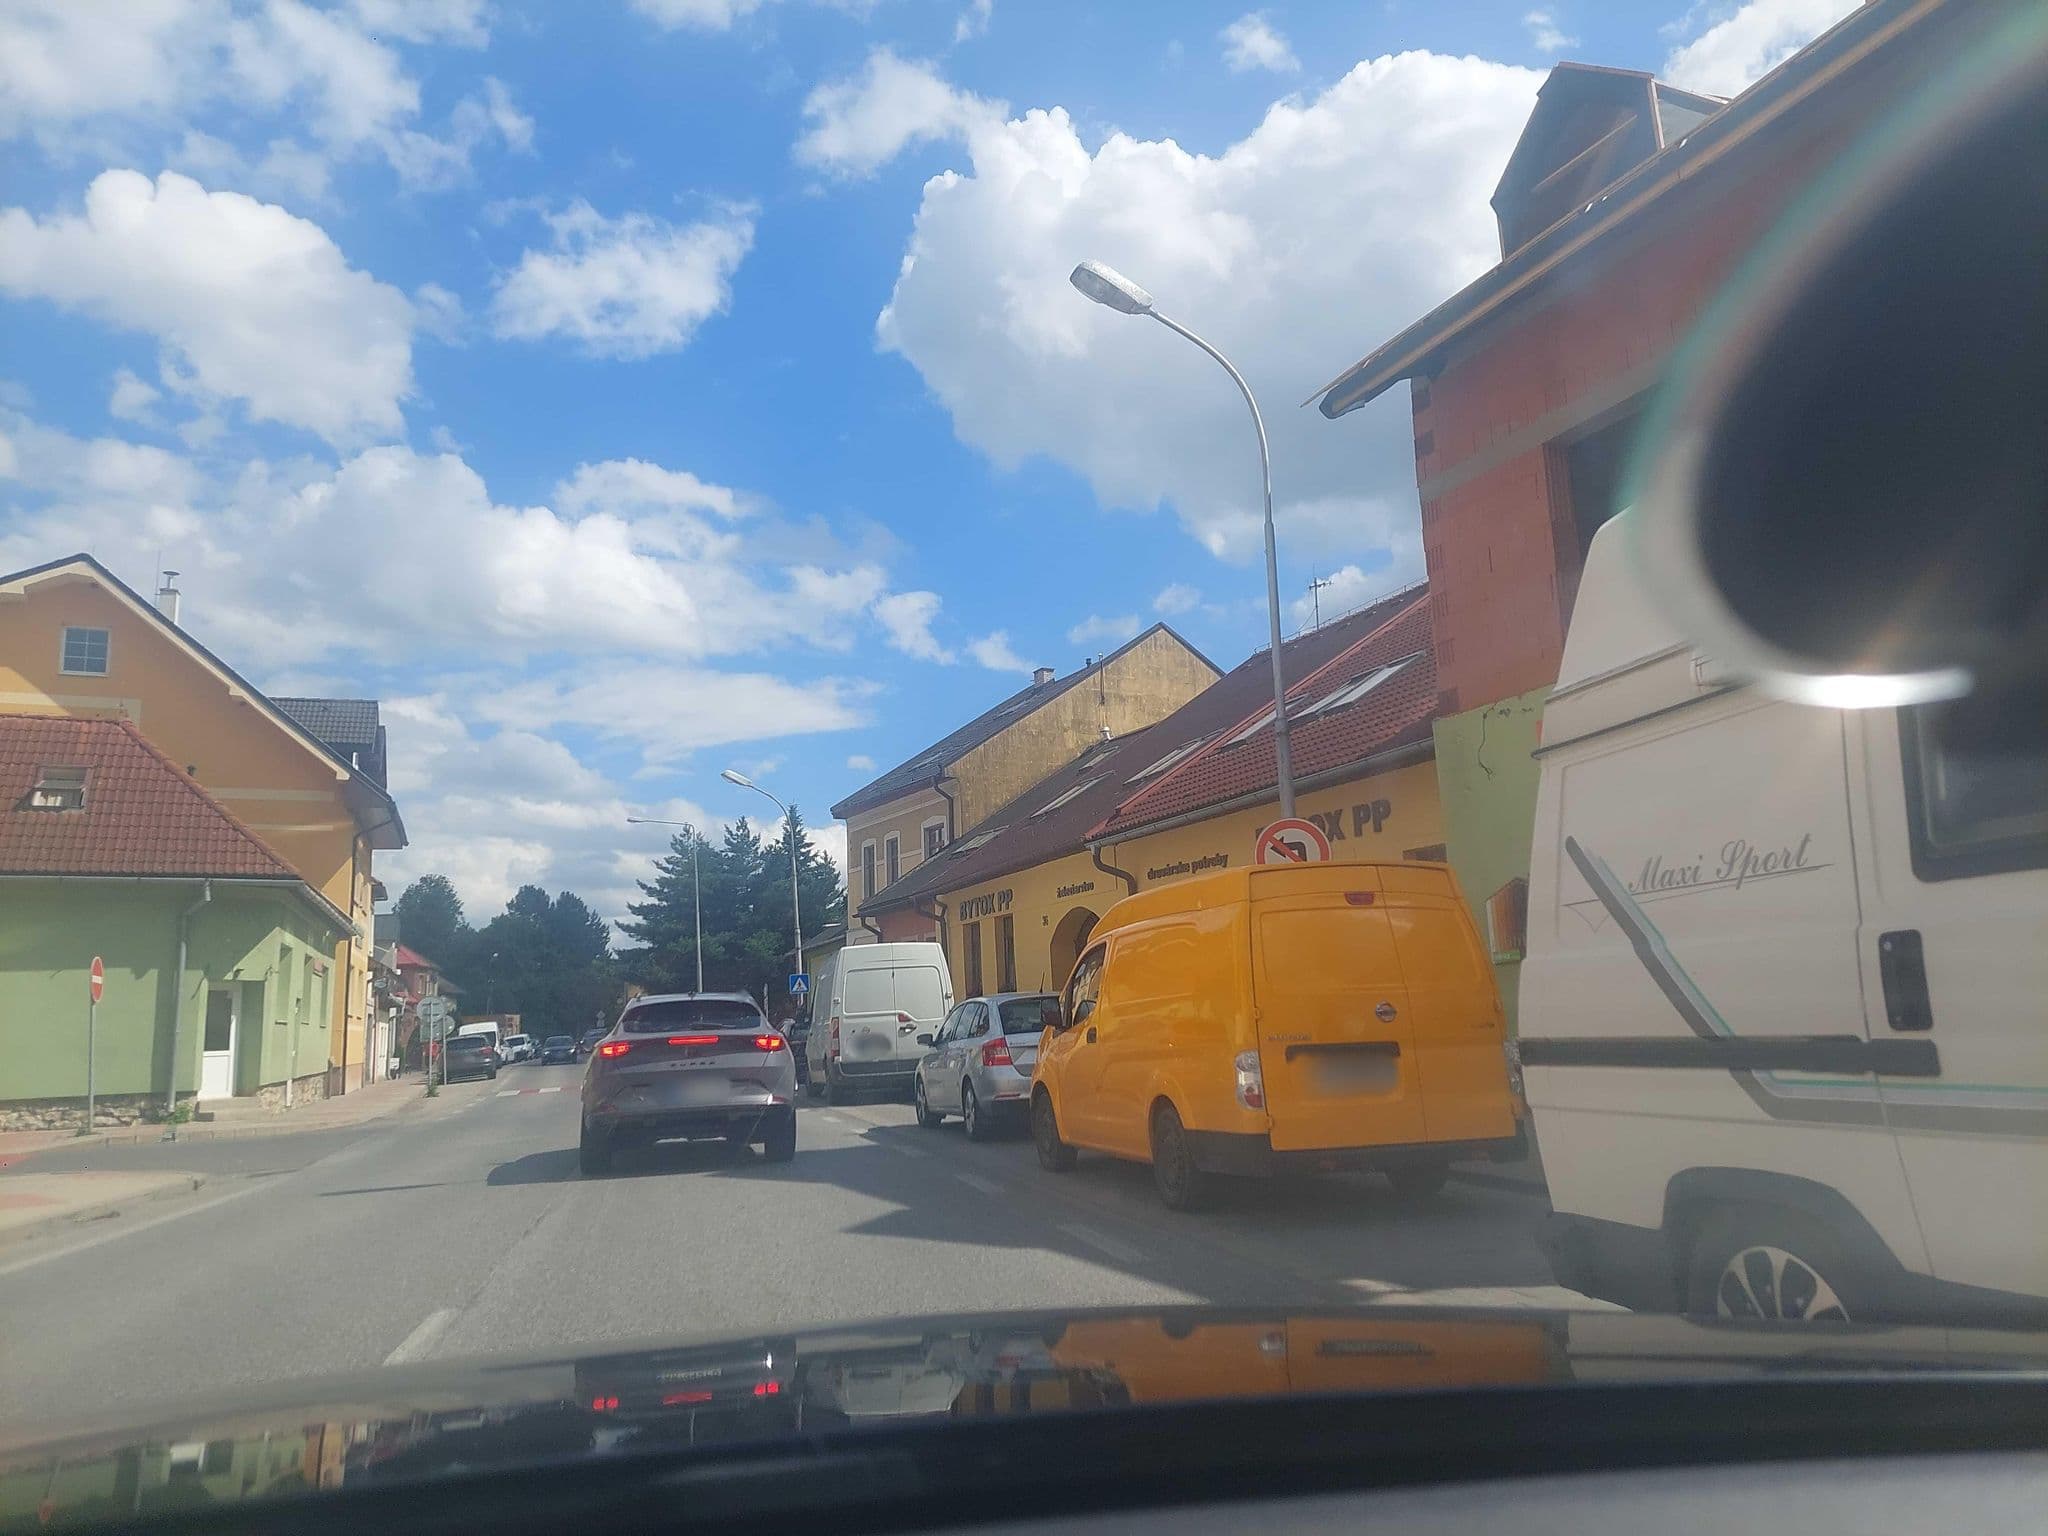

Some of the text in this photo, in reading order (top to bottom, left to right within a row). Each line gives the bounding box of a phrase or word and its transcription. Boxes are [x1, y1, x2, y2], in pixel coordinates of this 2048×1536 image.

[1352, 800, 1392, 837] PP
[1191, 853, 1229, 874] potreby
[1628, 832, 1813, 893] Maxi Sport
[959, 888, 1014, 921] BYTOX PP
